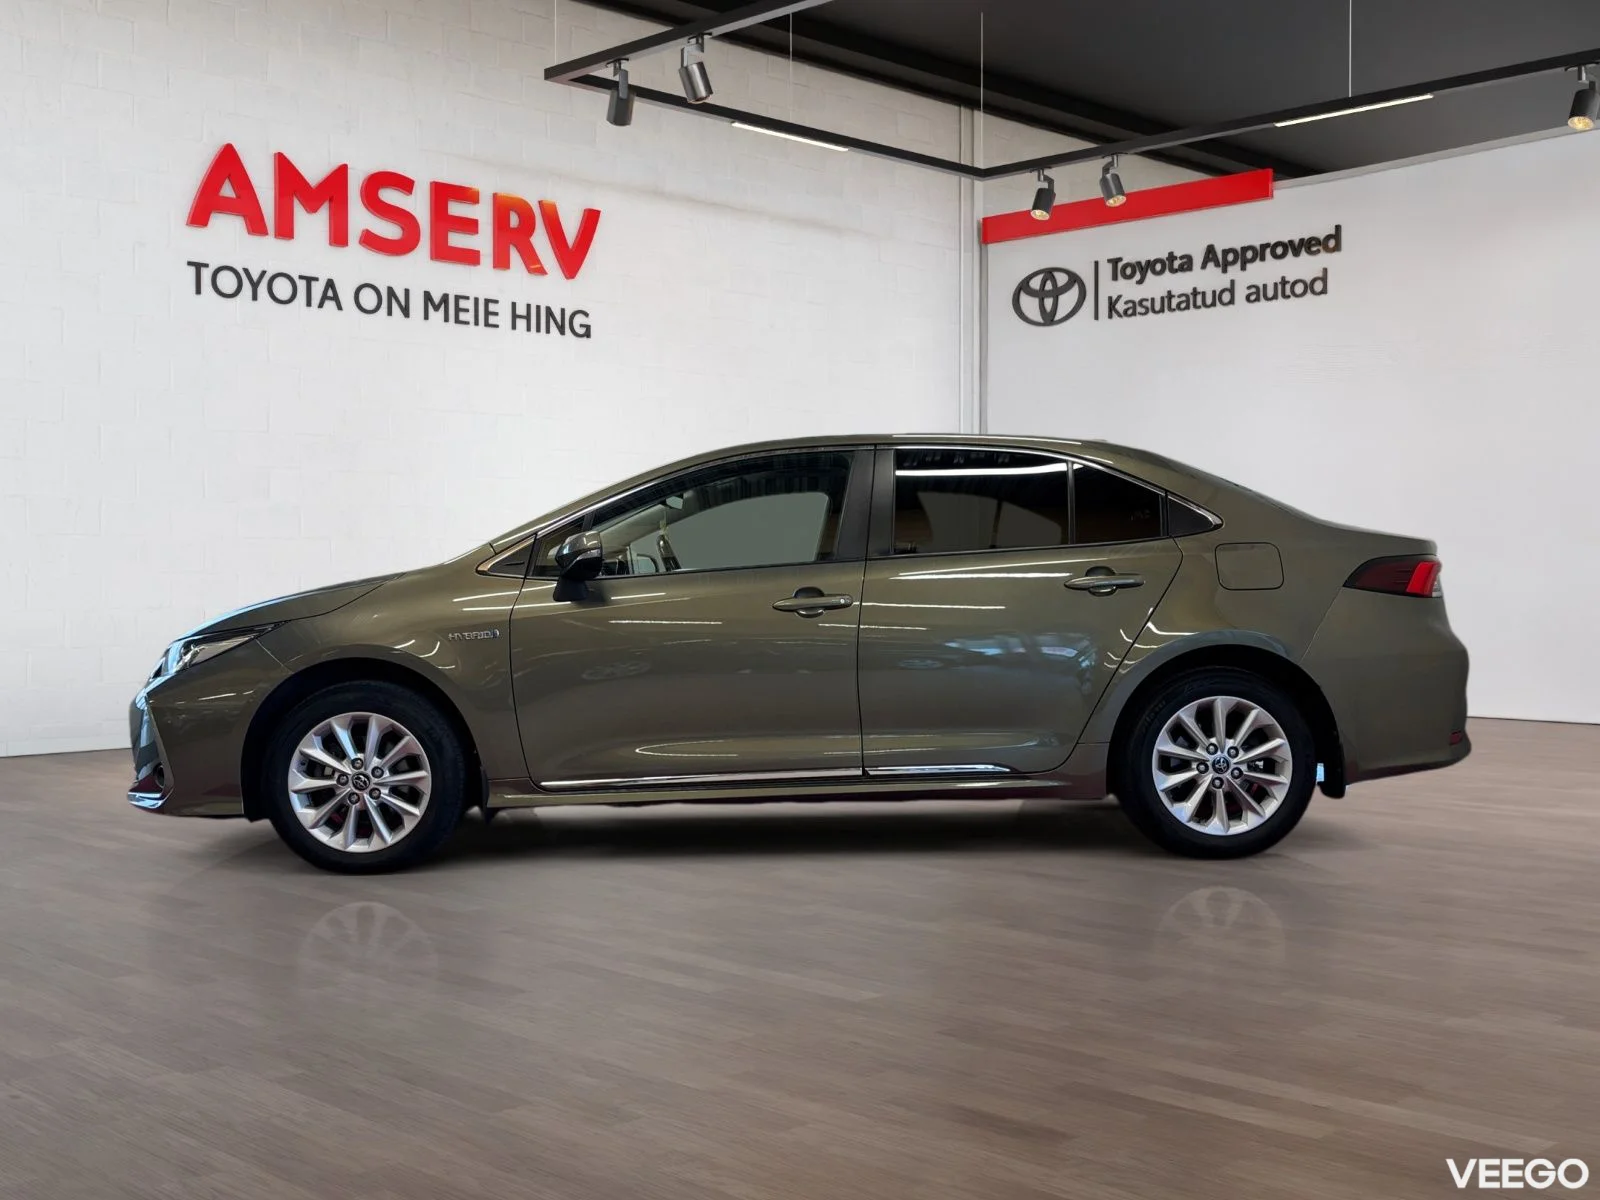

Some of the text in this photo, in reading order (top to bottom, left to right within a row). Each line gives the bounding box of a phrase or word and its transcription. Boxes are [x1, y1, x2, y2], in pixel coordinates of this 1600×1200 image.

[186, 143, 601, 280] AMSERV
[1107, 224, 1342, 285] Toyota Approved
[187, 261, 592, 338] TOYOTA ON MEIE HING
[1107, 267, 1328, 319] Kasutatud autod
